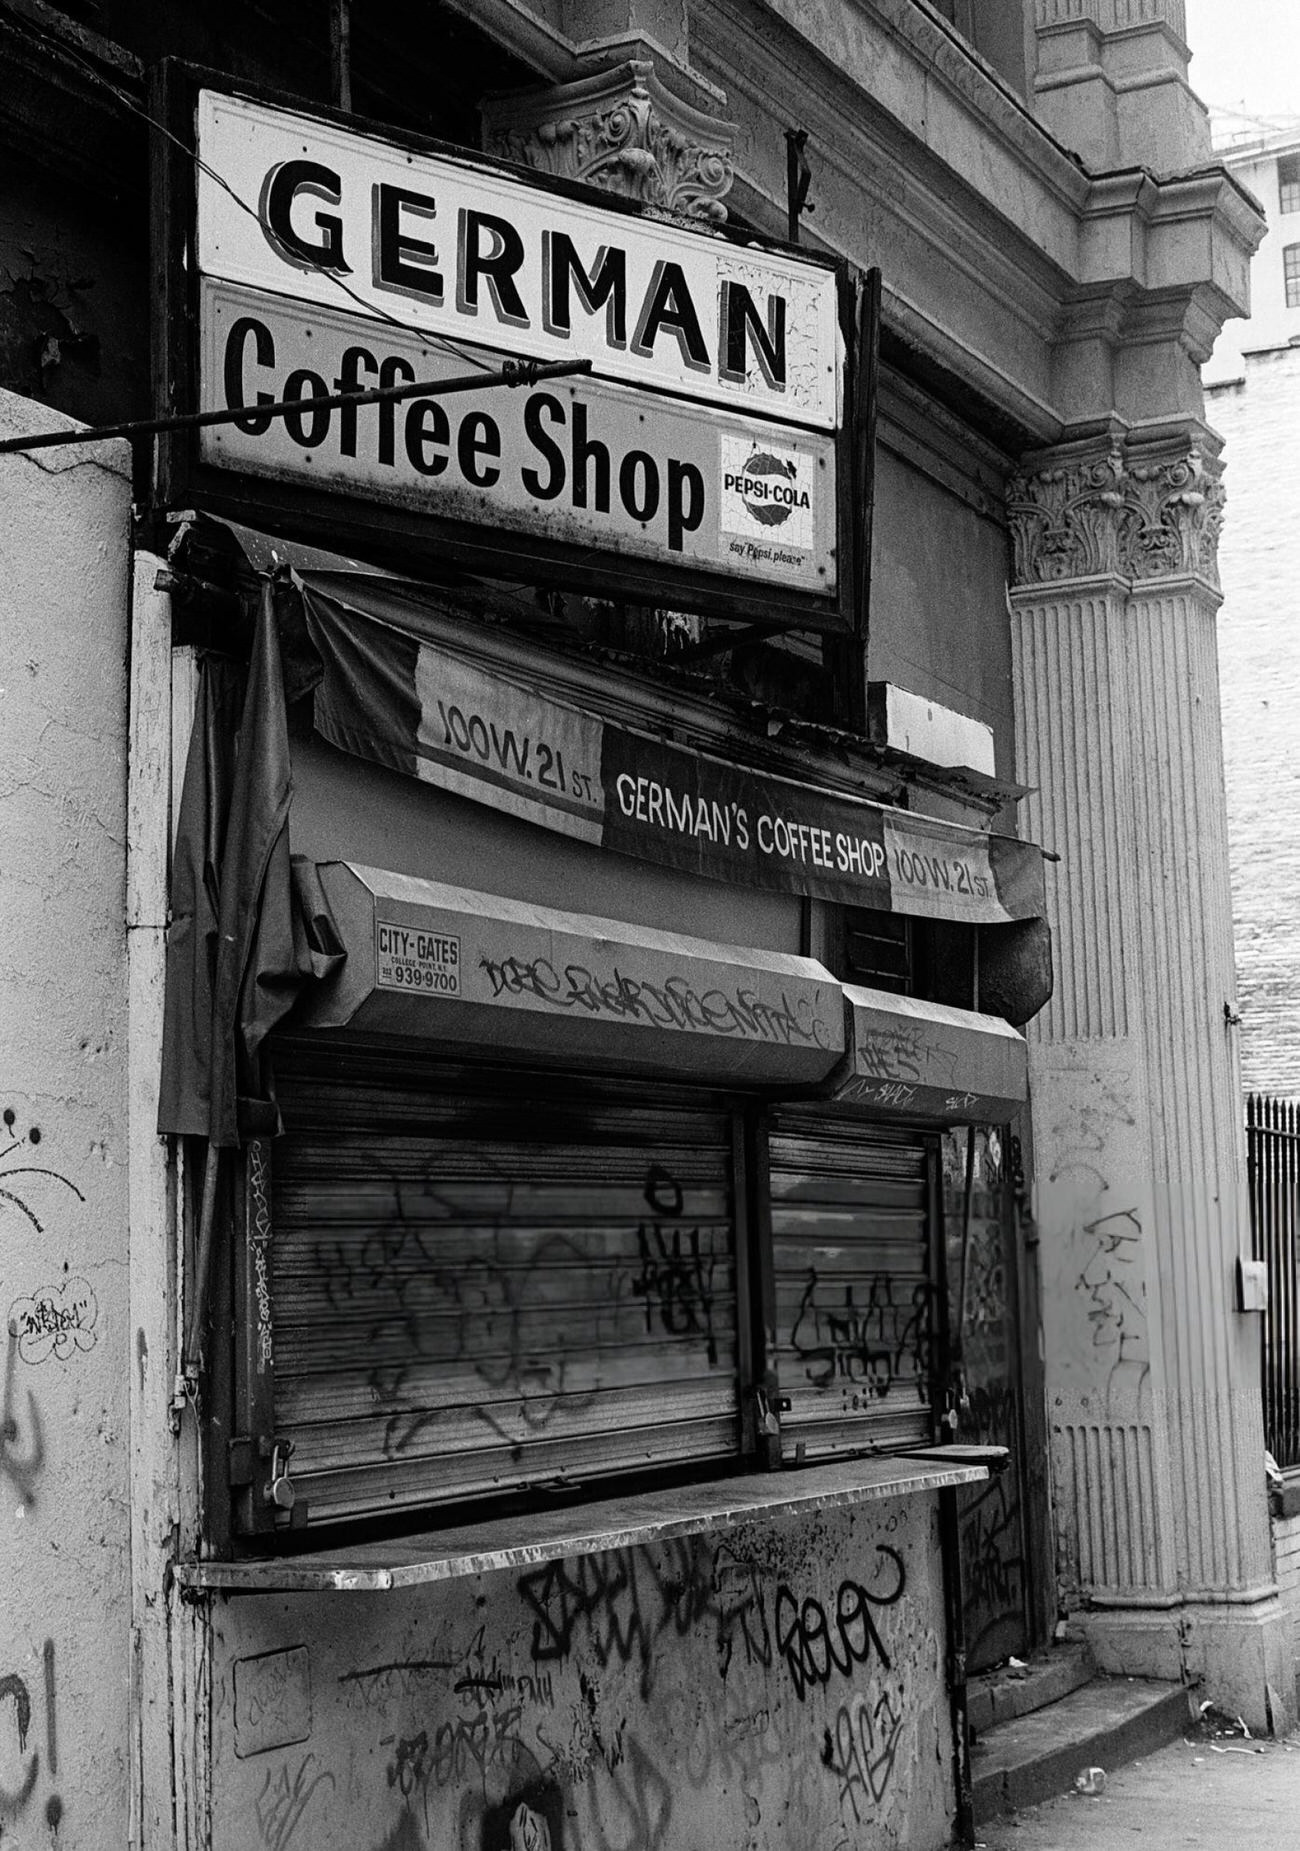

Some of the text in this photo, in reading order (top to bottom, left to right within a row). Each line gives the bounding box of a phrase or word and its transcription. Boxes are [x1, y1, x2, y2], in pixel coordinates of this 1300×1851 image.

[259, 159, 787, 392] GERMAN
[224, 317, 706, 550] Coffee Shop
[616, 773, 885, 878] GERMAN'S COFFEE SHOP
